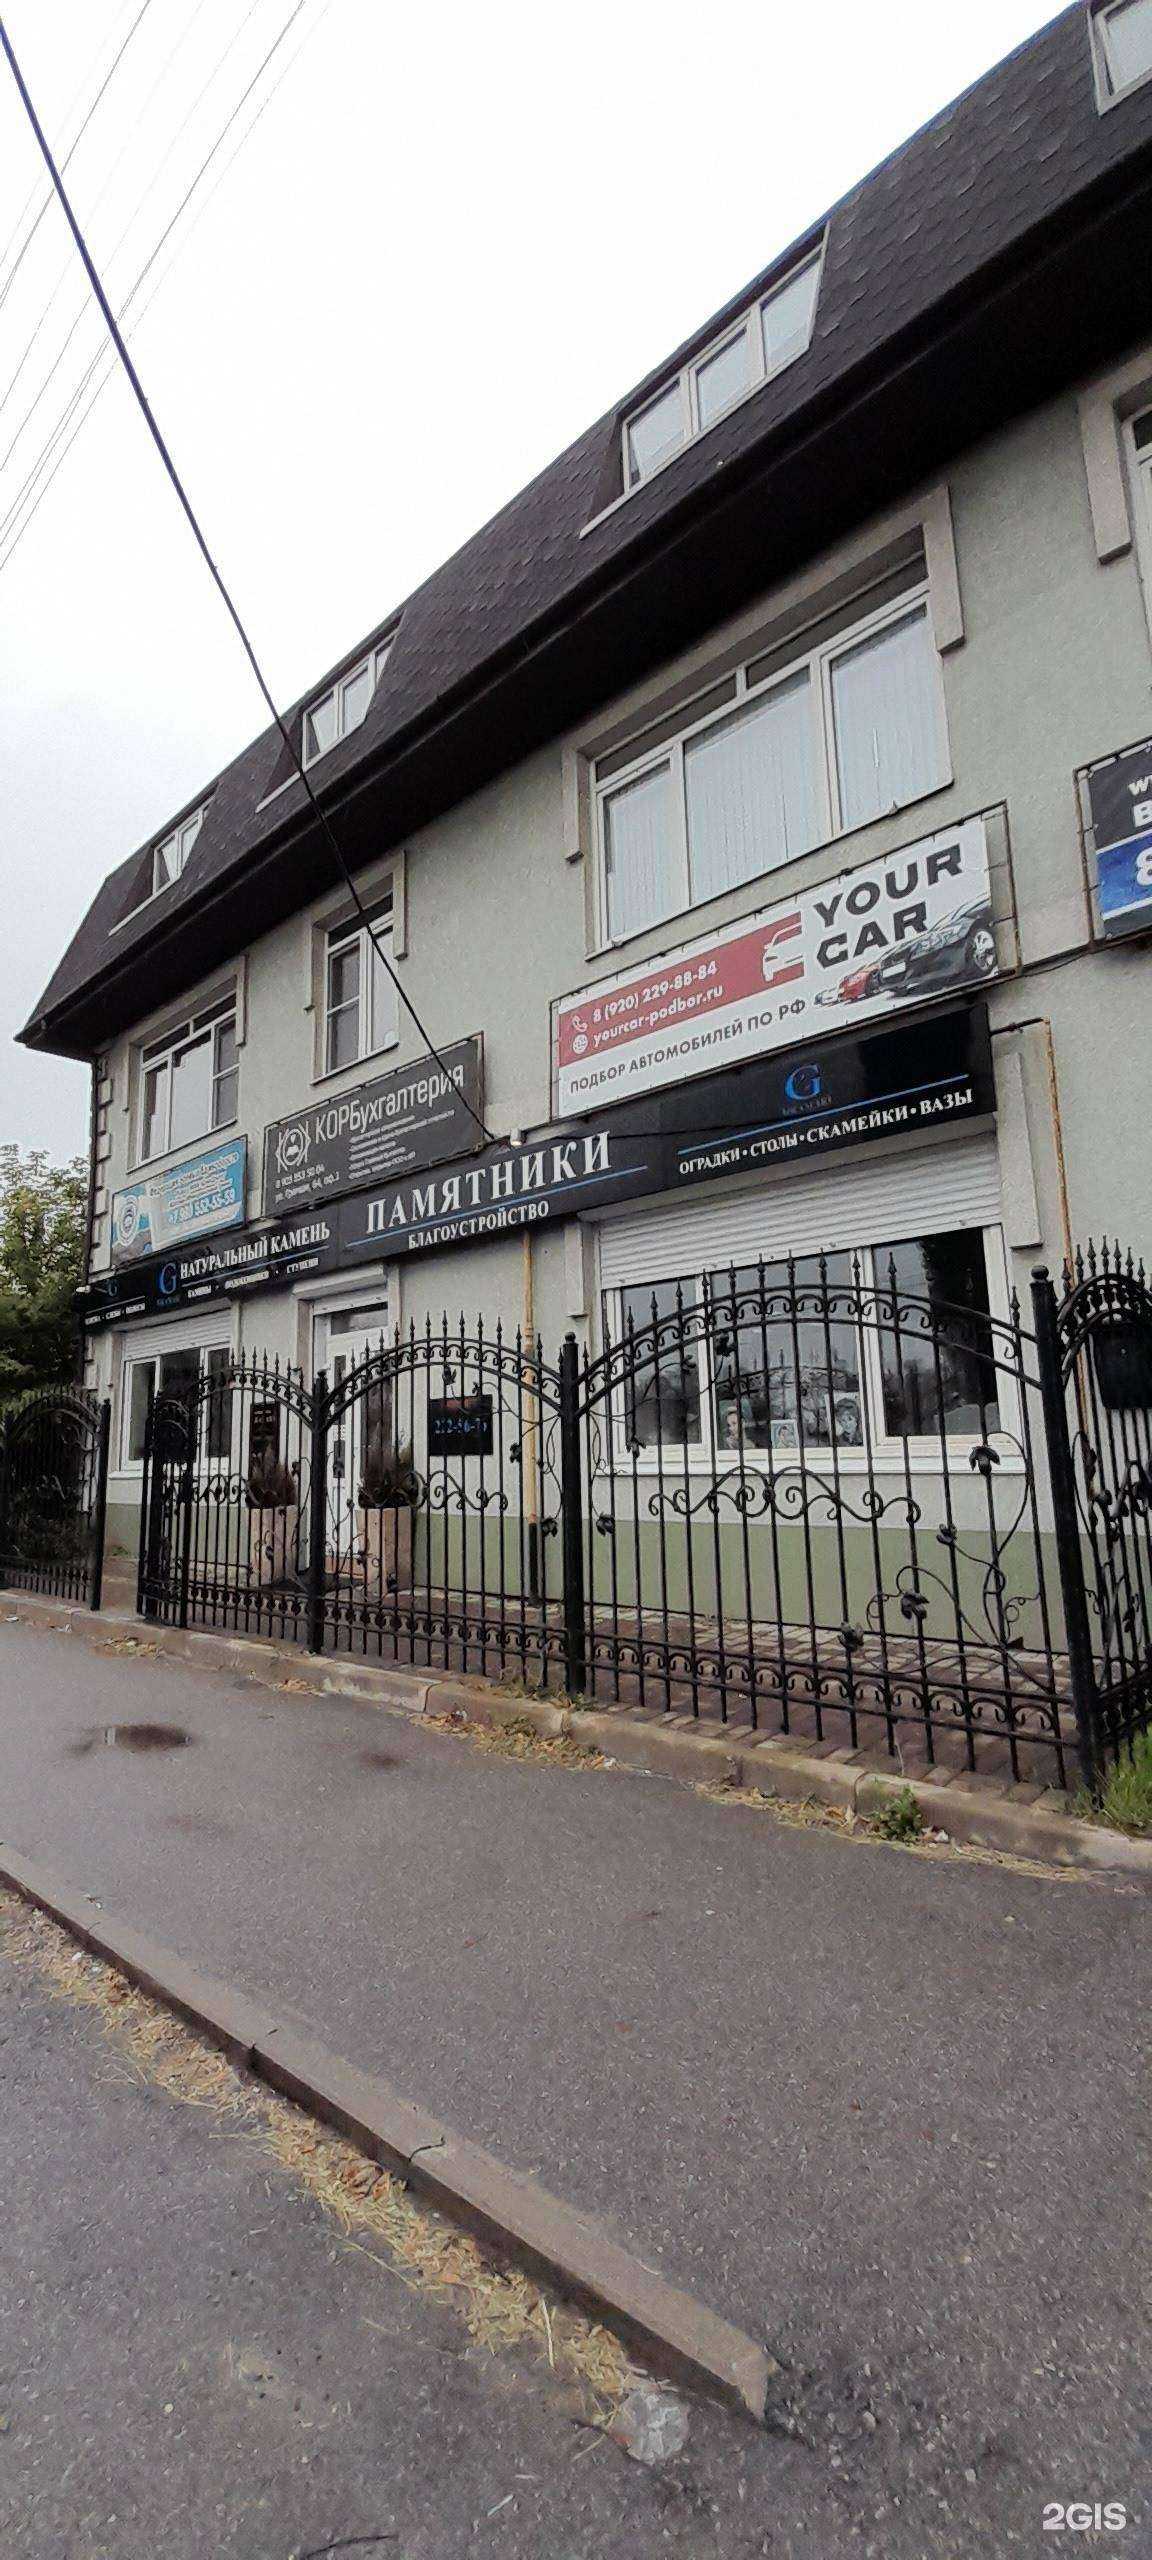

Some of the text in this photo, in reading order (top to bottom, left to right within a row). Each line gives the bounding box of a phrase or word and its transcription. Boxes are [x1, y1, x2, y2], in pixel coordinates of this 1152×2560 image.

[813, 844, 963, 928] YOUR
[816, 901, 930, 969] CAR
[592, 960, 718, 1023] 8 (920) 229-88-84
[592, 985, 724, 1048] yourcar-podbor.ru
[570, 999, 806, 1094] ПОДБОР АВТОМОБИЛЕЙ ПО РФ
[315, 1064, 465, 1144] КОРБухгалтерия
[679, 1150, 740, 1175] ОГРАДКИ
[749, 1131, 798, 1158] СТОЛЫ
[806, 1106, 909, 1144] СКАМЕЙКИ
[920, 1088, 973, 1116] ВАЗЫ
[366, 1131, 612, 1235] ПАМЯТНИКИ
[180, 1221, 331, 1280] НАТУРАЛЬНЫЙ КАМЕНЬ
[408, 1200, 549, 1250] БЛАГОУСТРОЙСТВО
